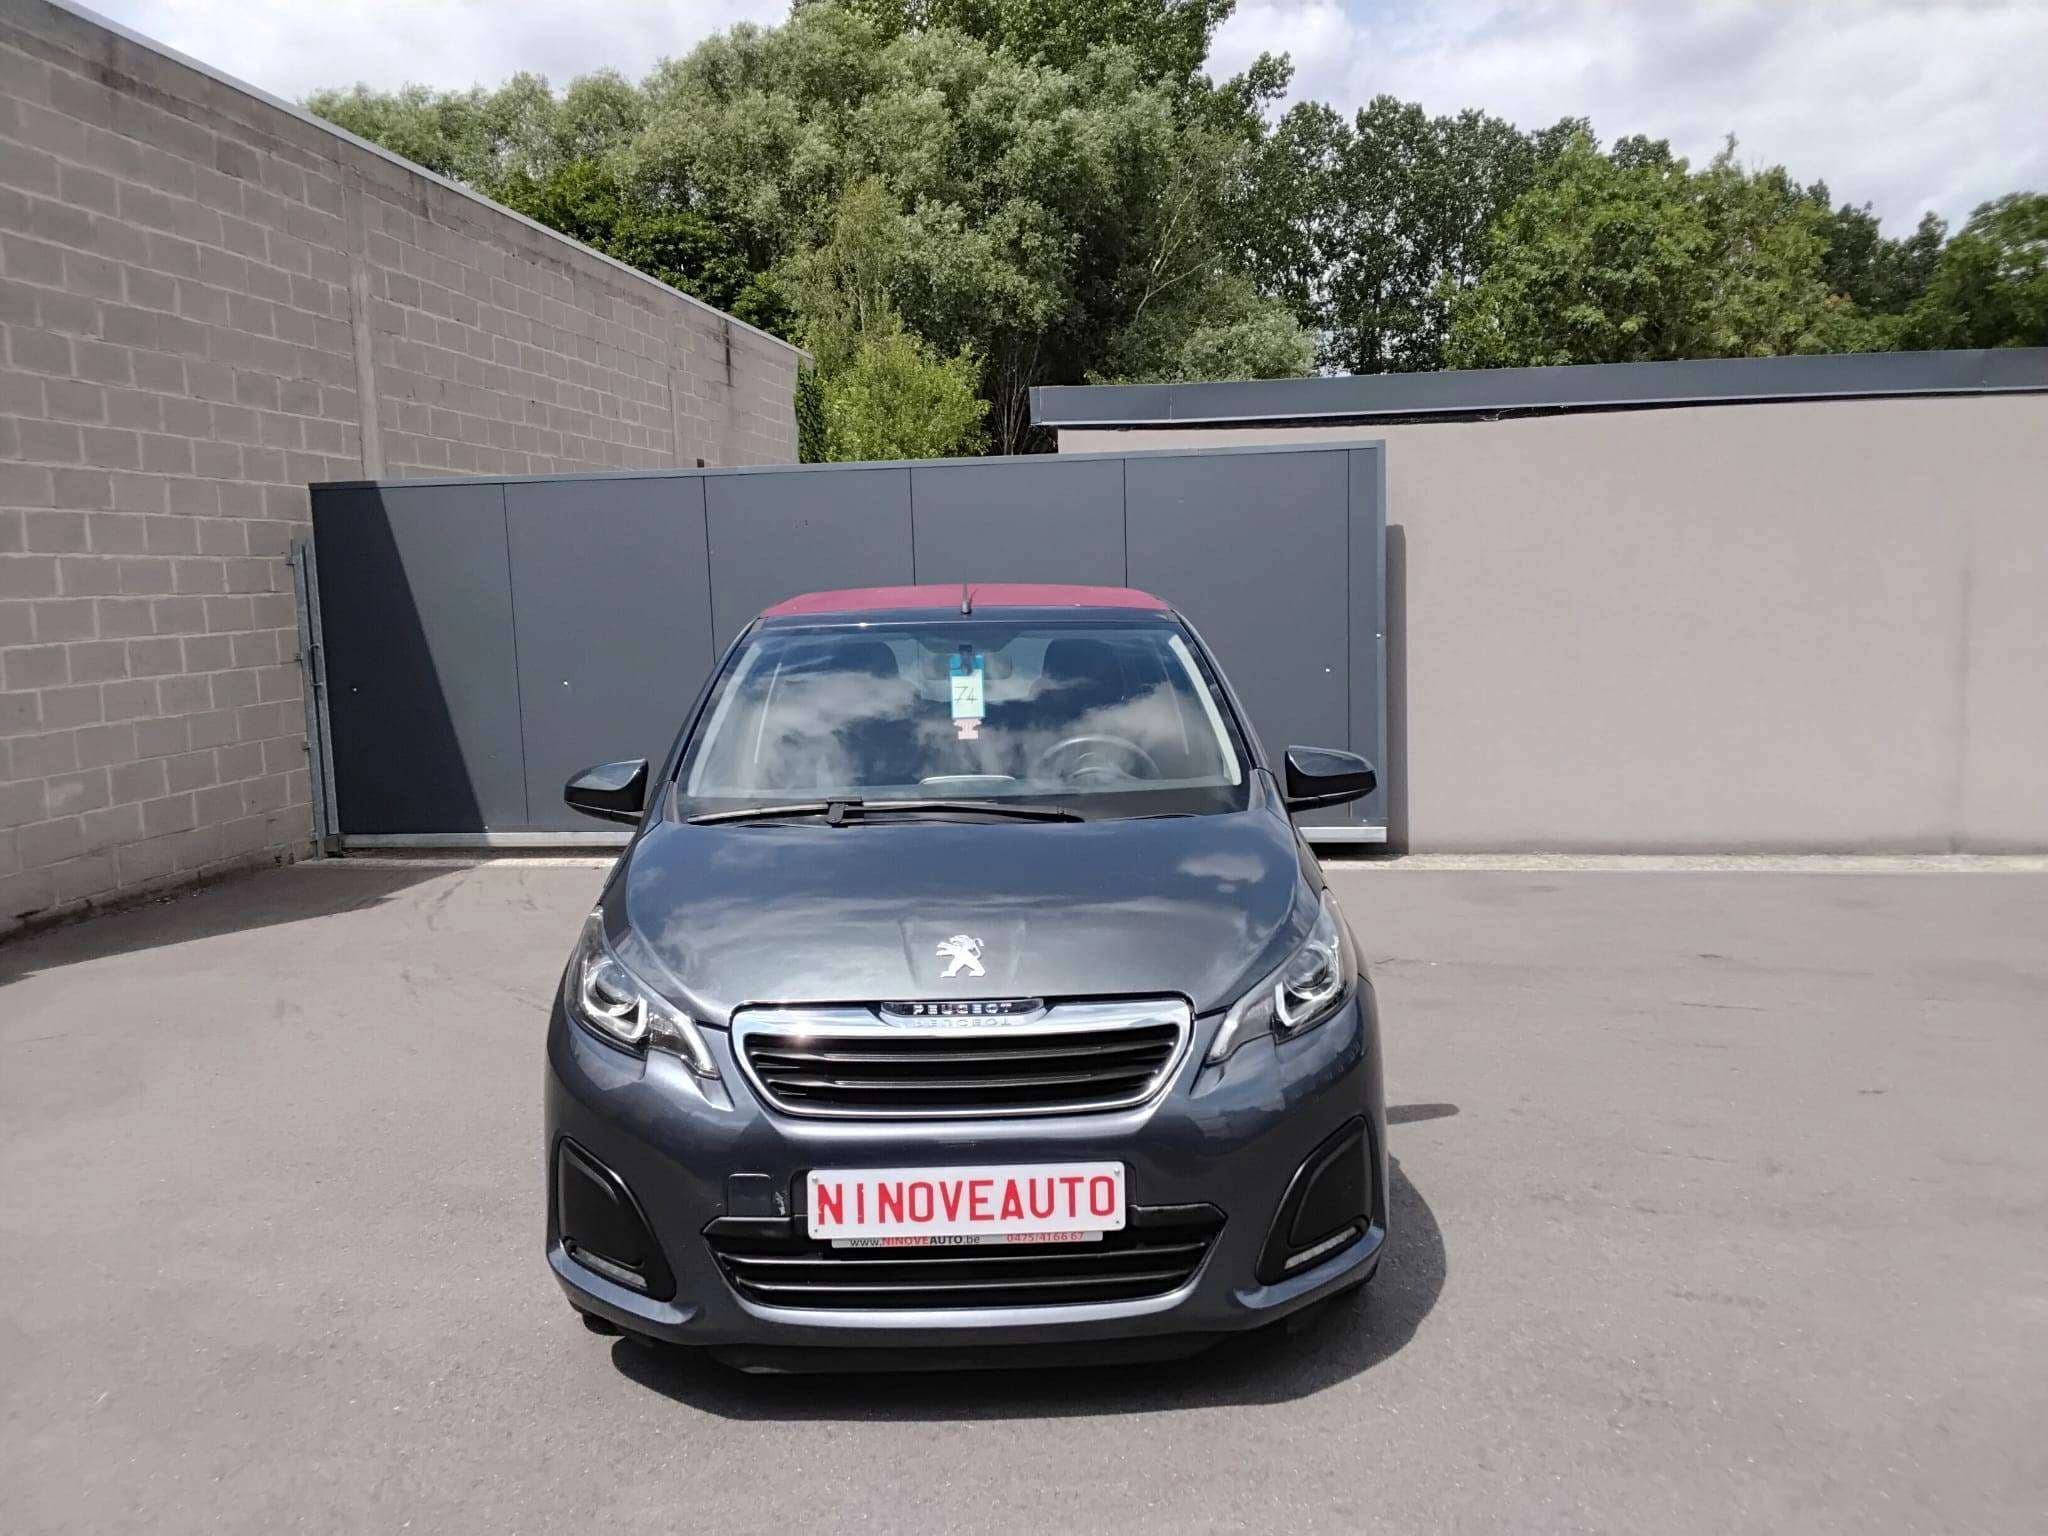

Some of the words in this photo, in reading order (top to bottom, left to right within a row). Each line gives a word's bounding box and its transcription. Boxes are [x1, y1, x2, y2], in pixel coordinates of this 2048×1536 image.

[913, 1003, 1012, 1015] PEUGEOT
[817, 1176, 1115, 1226] NINOVEAUTO
[849, 1234, 981, 1247] www.NINOVEAUTO.be
